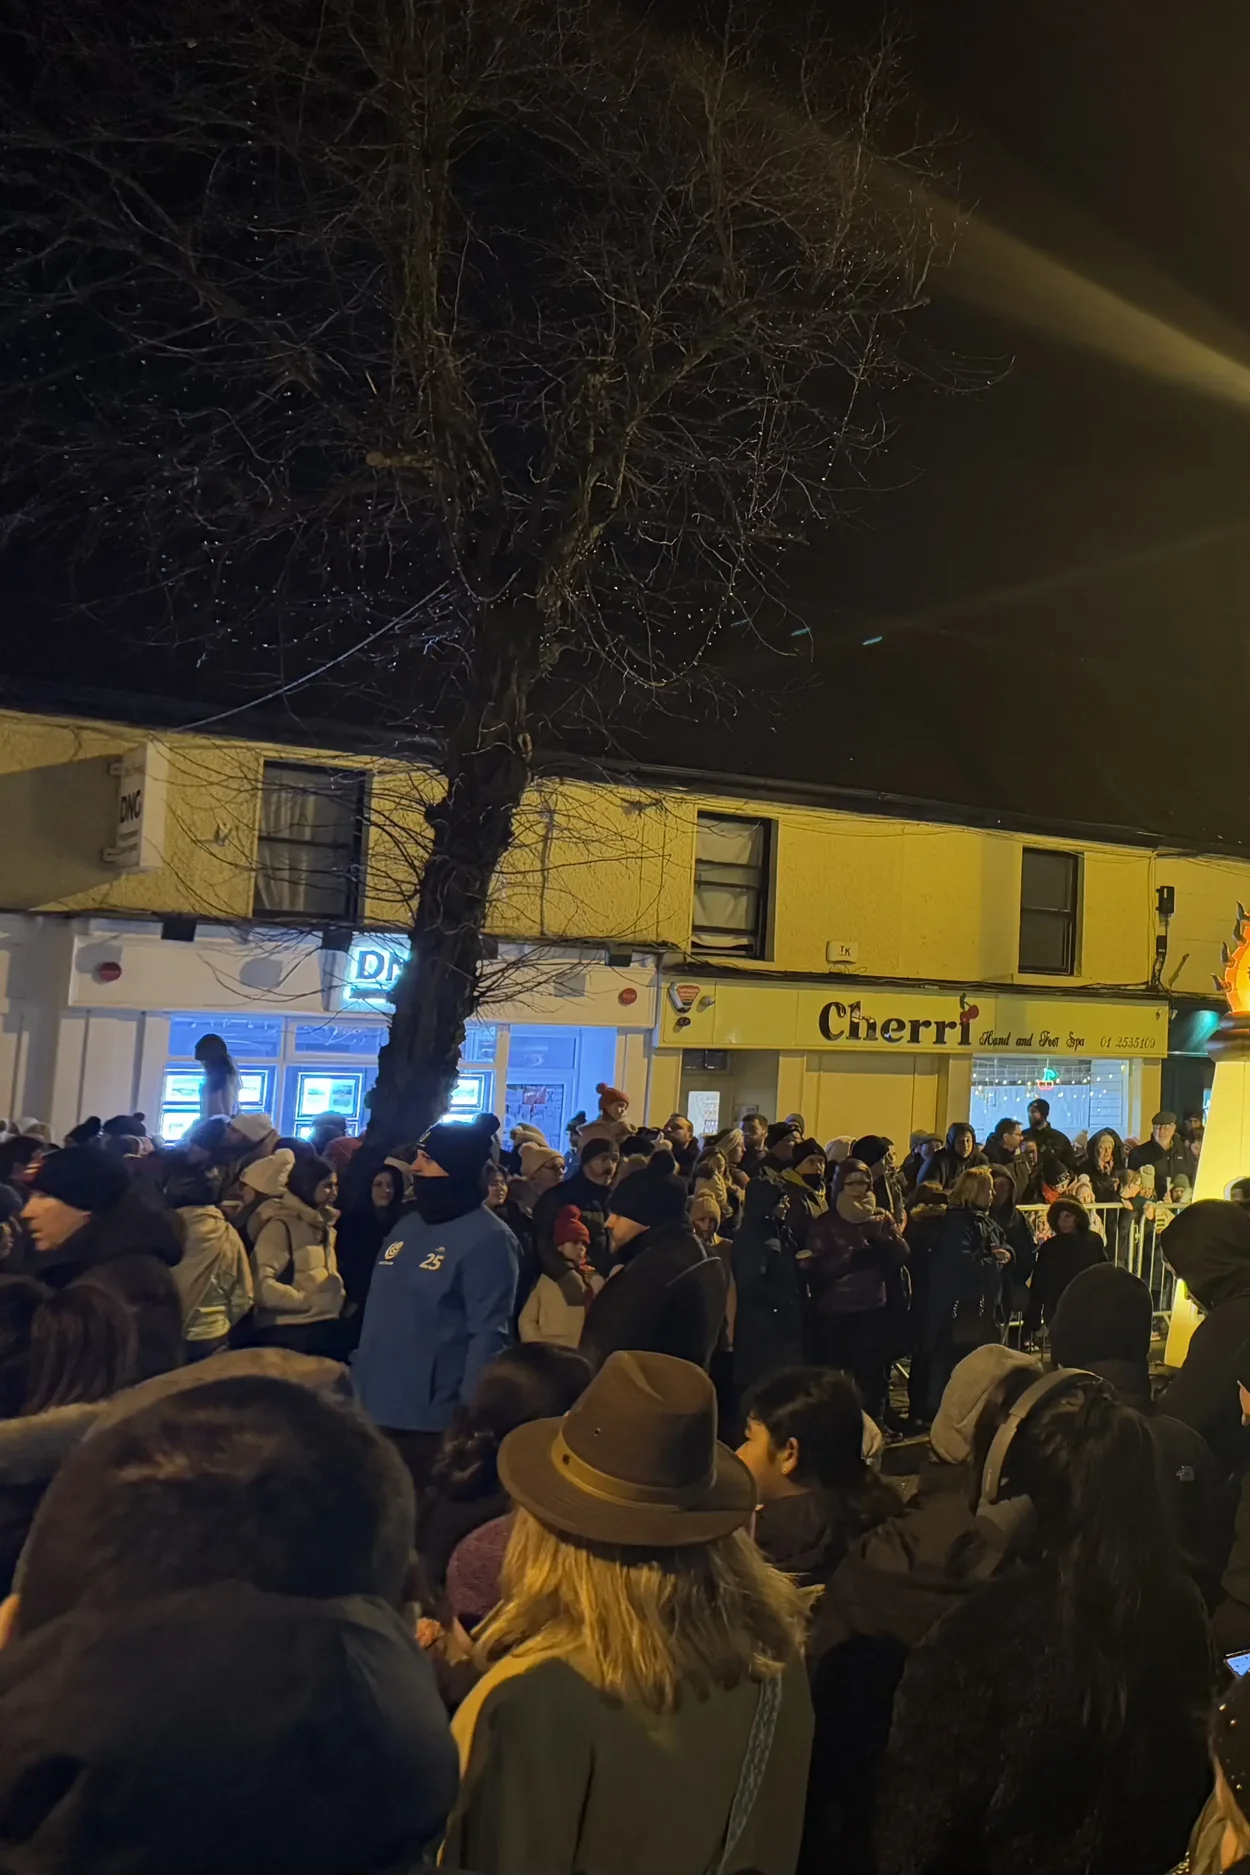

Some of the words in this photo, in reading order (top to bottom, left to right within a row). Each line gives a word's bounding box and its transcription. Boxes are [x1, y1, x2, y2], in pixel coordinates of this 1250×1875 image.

[120, 789, 141, 824] DNG
[818, 1000, 974, 1046] Cherri
[978, 1030, 1012, 1047] Hand
[1015, 1032, 1034, 1047] and
[1065, 1031, 1085, 1052] Spa
[1099, 1036, 1112, 1048] 01
[419, 1252, 445, 1270] 25
